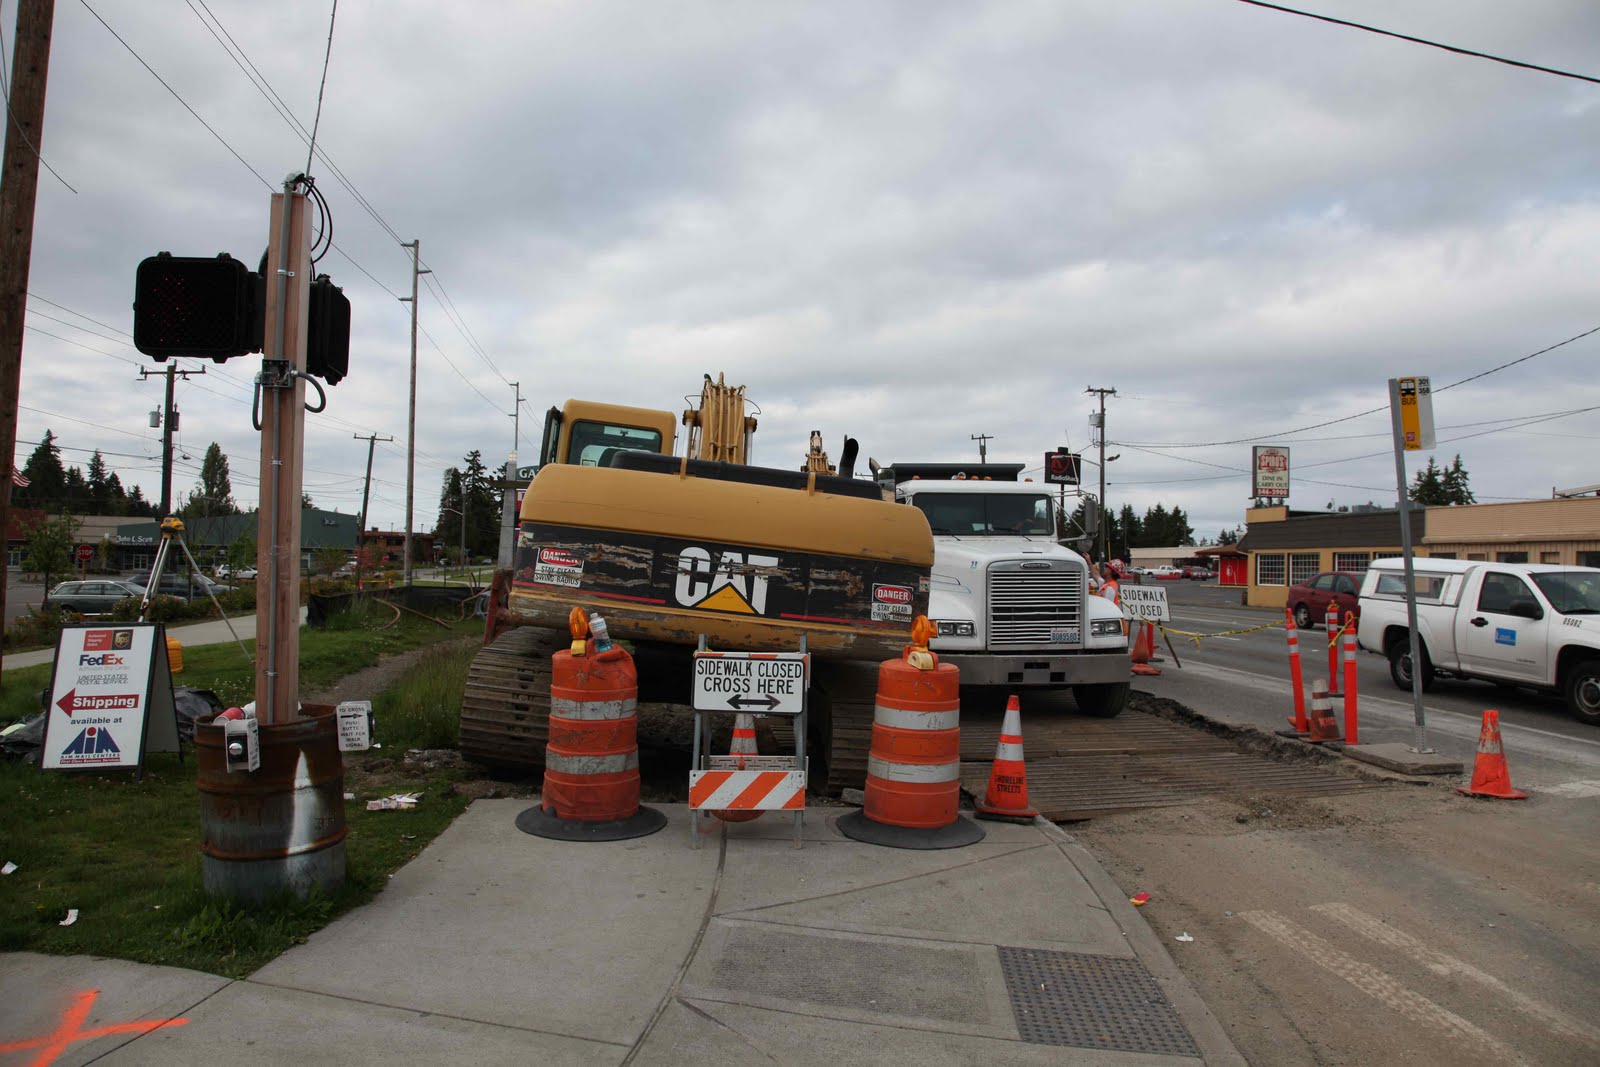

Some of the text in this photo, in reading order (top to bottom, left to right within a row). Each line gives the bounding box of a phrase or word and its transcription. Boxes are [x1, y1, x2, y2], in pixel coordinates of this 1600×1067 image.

[1401, 397, 1417, 405] BUS
[519, 468, 539, 478] GA
[115, 535, 131, 543] John
[541, 565, 556, 573] STAY
[535, 574, 579, 586] SWING RADIUS
[674, 547, 779, 615] CAT
[877, 589, 909, 601] DANGER
[1122, 589, 1166, 602] SIDEWALK
[891, 605, 908, 613] CLEAR
[1130, 604, 1163, 617] CLOSED
[872, 611, 891, 620] SWING
[116, 636, 130, 645] ups
[79, 653, 124, 666] FedEx
[697, 659, 802, 678] SIDEWALK CLOSED
[703, 676, 794, 695] CROSS HERE
[72, 696, 136, 709] Shipping
[70, 717, 111, 725] available
[994, 775, 1024, 784] SHORELINE
[996, 783, 1021, 794] STREETS
